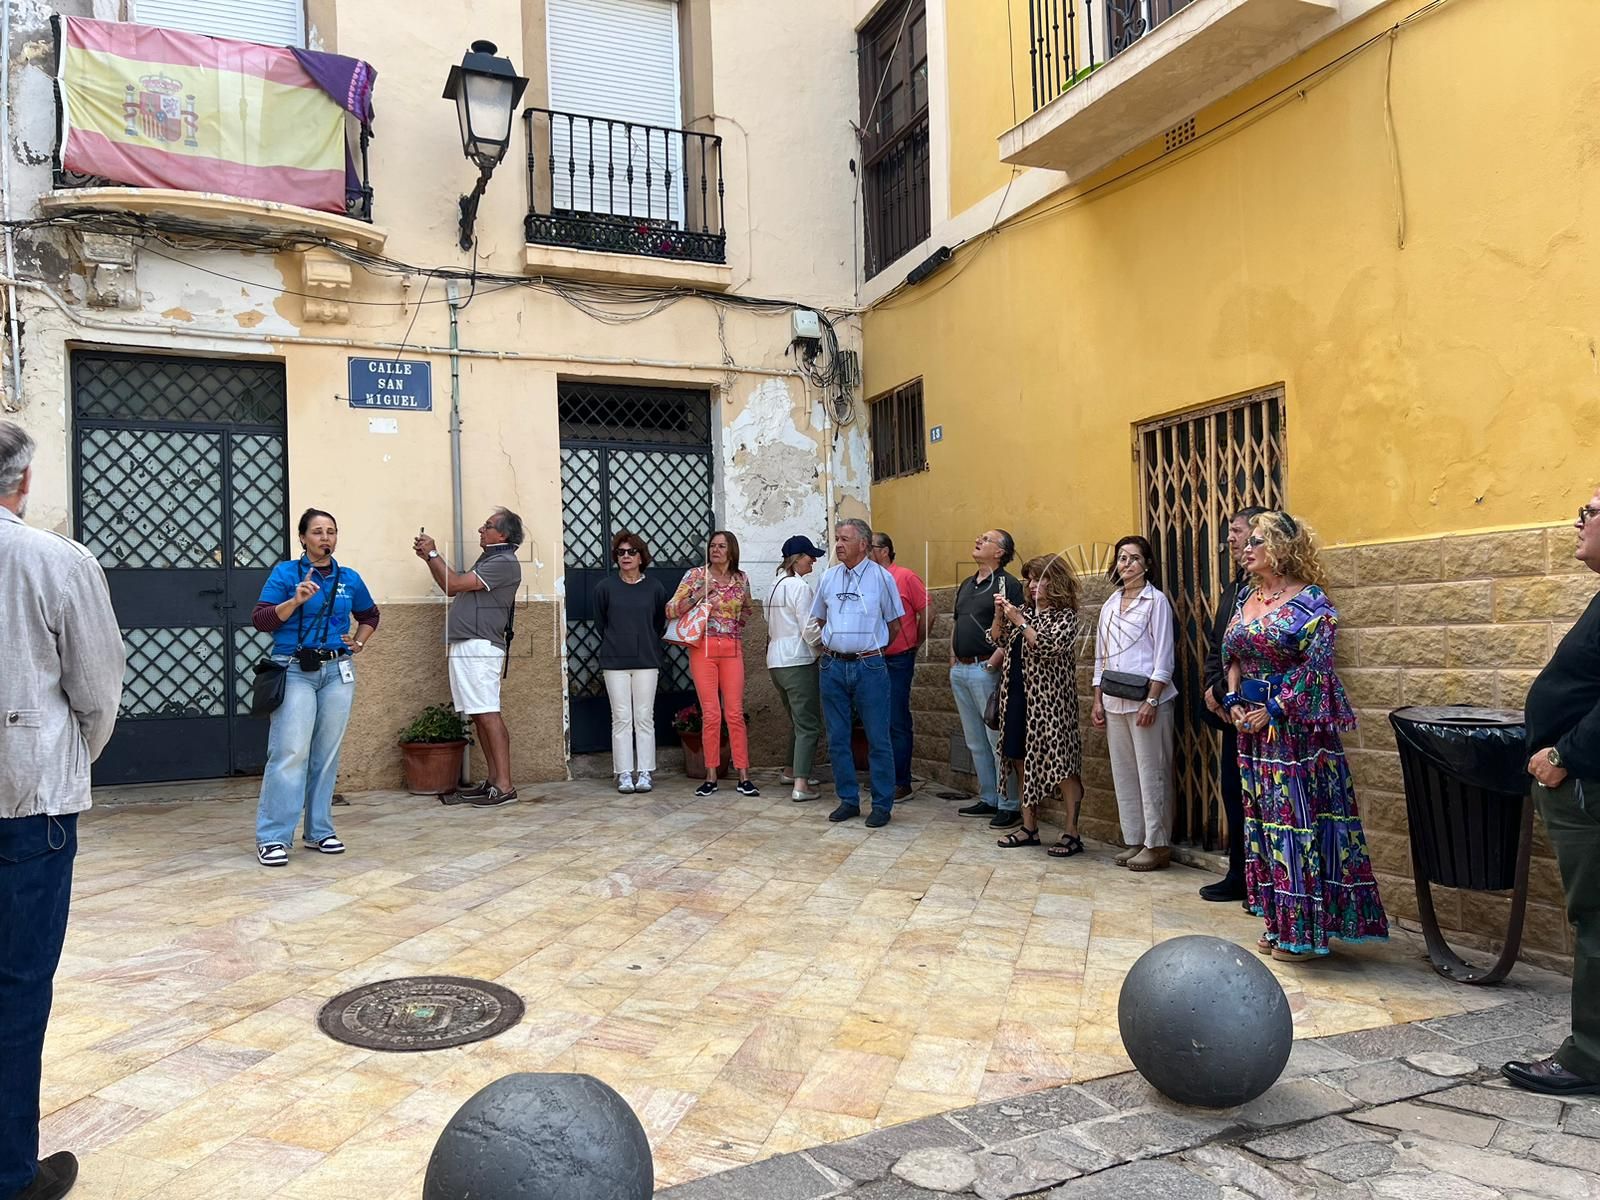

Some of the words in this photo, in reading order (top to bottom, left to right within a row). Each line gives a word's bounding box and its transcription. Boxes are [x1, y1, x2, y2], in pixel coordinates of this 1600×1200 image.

[368, 361, 412, 375] CALLE
[378, 379, 403, 390] SAN
[366, 393, 418, 407] MIGUEL
